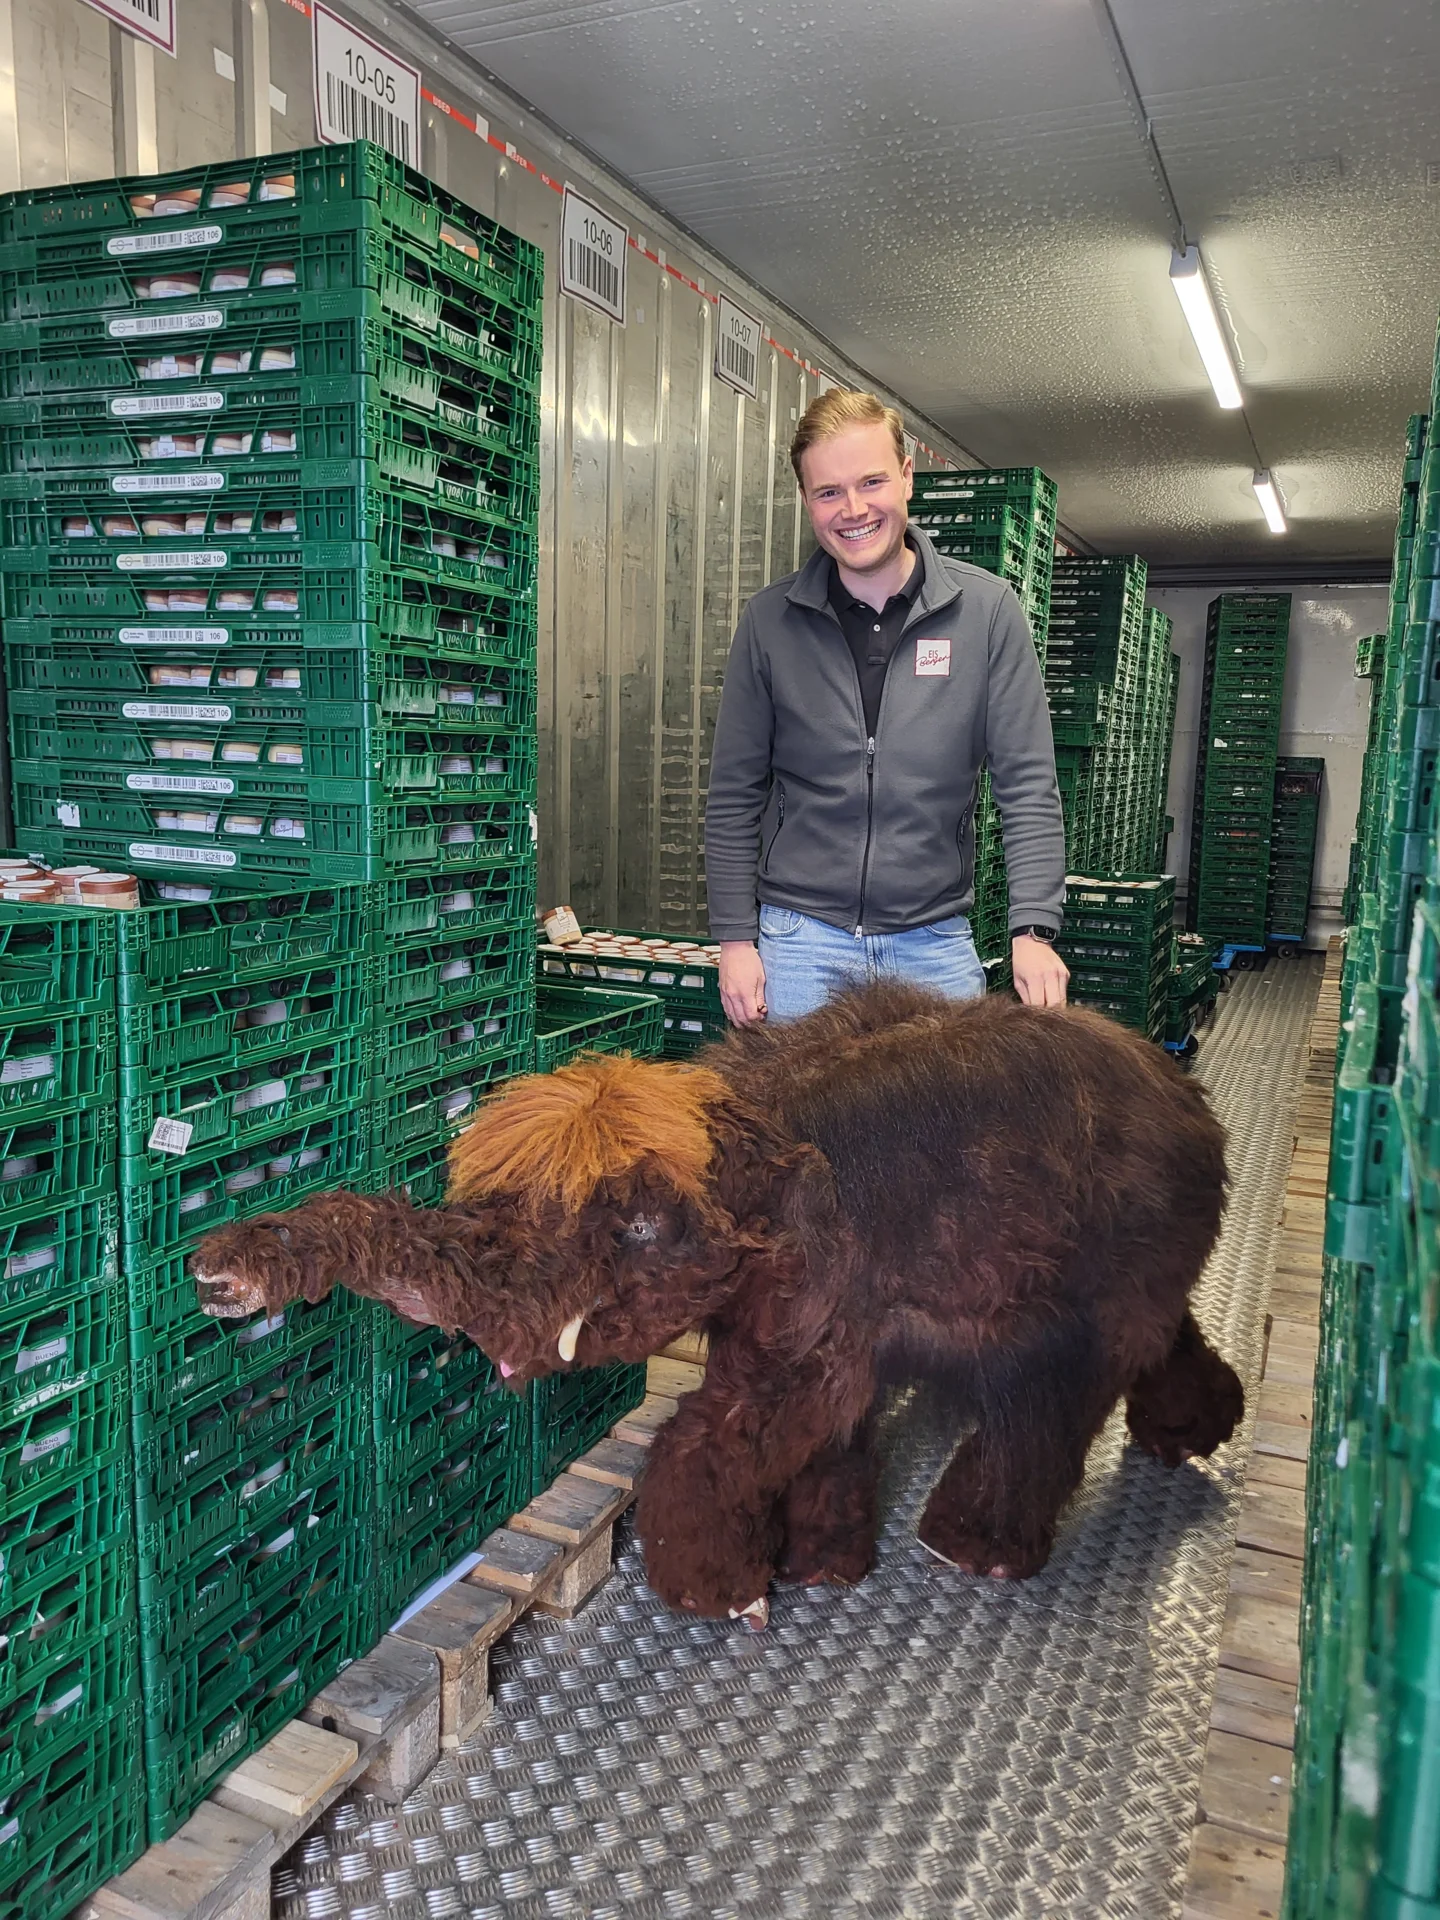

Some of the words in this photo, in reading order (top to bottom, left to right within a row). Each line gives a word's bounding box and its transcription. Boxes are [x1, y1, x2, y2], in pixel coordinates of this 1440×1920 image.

[345, 48, 395, 104] 10-05
[207, 230, 219, 239] 106
[583, 217, 613, 256] 10-06
[207, 315, 219, 324] 106
[730, 316, 752, 345] 10-07
[209, 396, 221, 405] 106
[210, 476, 222, 485] 106
[212, 555, 225, 563] 106
[210, 632, 221, 640] 106
[928, 649, 939, 660] EIS
[217, 709, 229, 717] 106
[219, 782, 231, 790] 106
[222, 854, 234, 863] 106
[35, 1350, 59, 1360] BUENO
[34, 1436, 59, 1447] BUENO
[33, 1441, 61, 1453] BERGER
